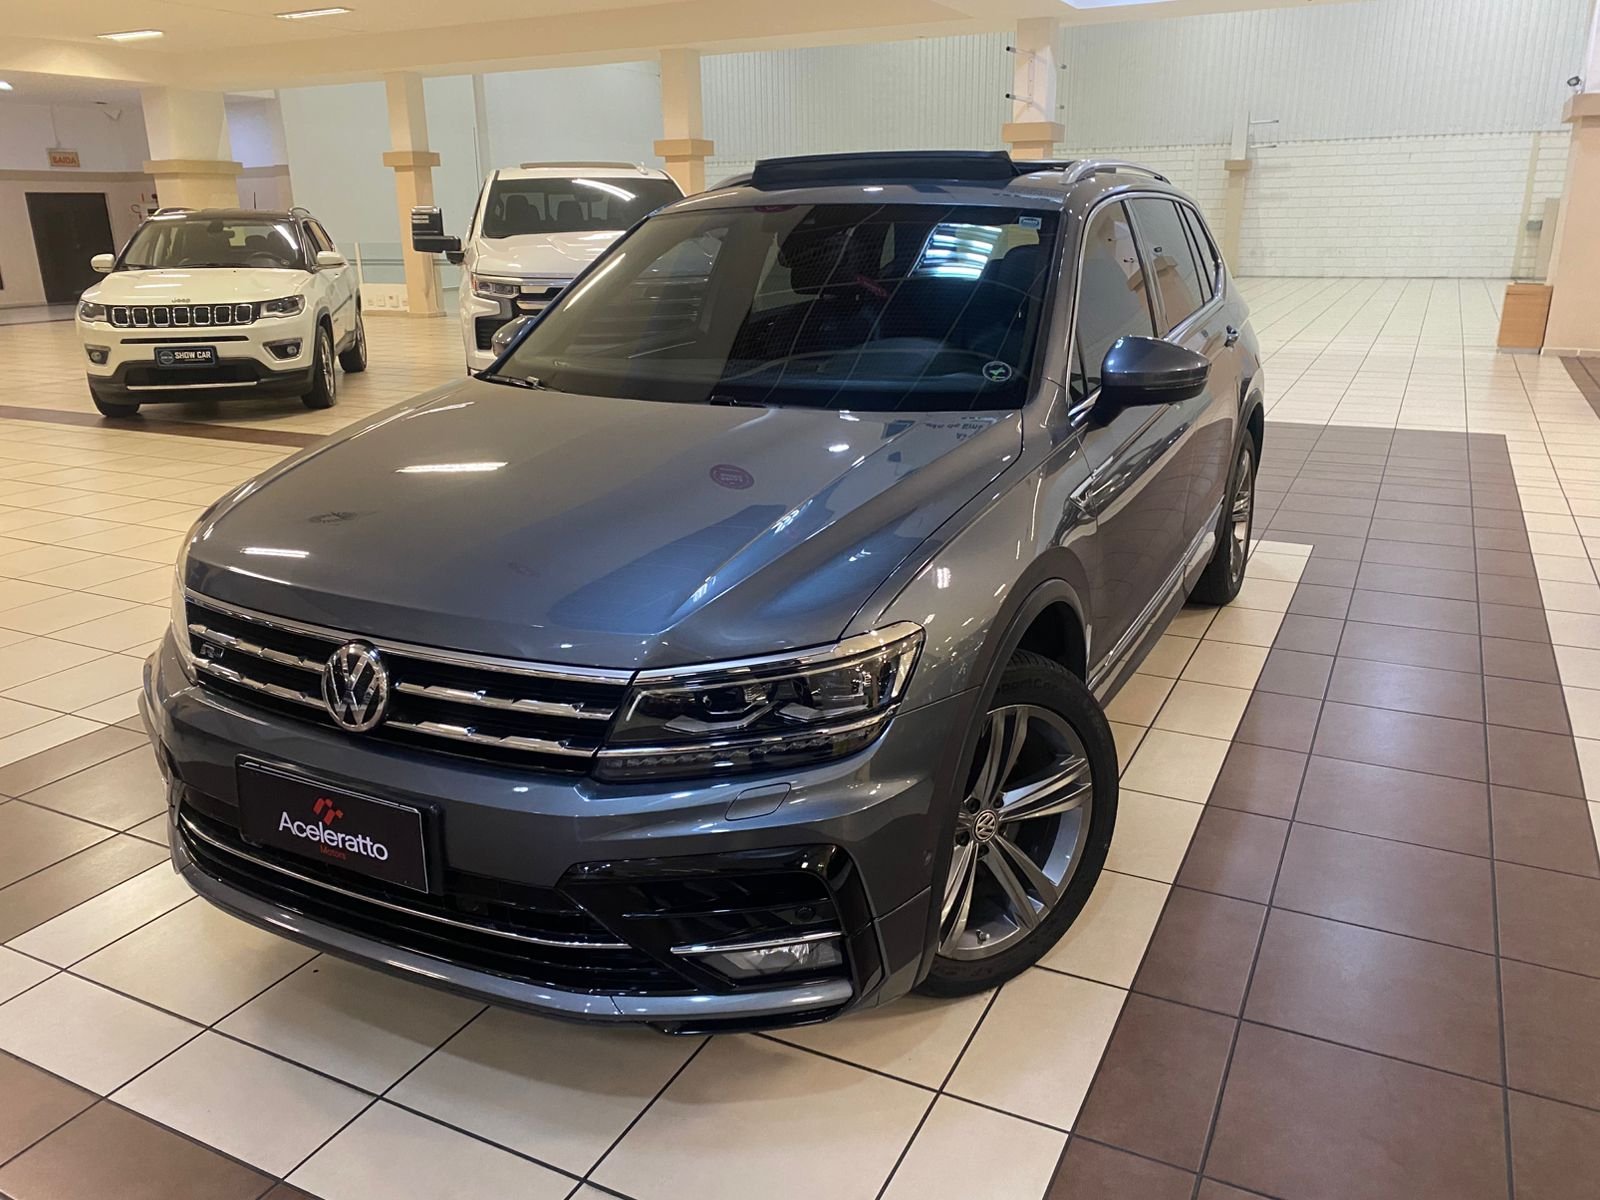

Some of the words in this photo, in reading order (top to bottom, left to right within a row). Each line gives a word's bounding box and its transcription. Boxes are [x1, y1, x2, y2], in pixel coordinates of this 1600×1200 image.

[174, 351, 195, 360] SHOW
[196, 350, 212, 359] CAR
[278, 811, 388, 861] Aceleratto
